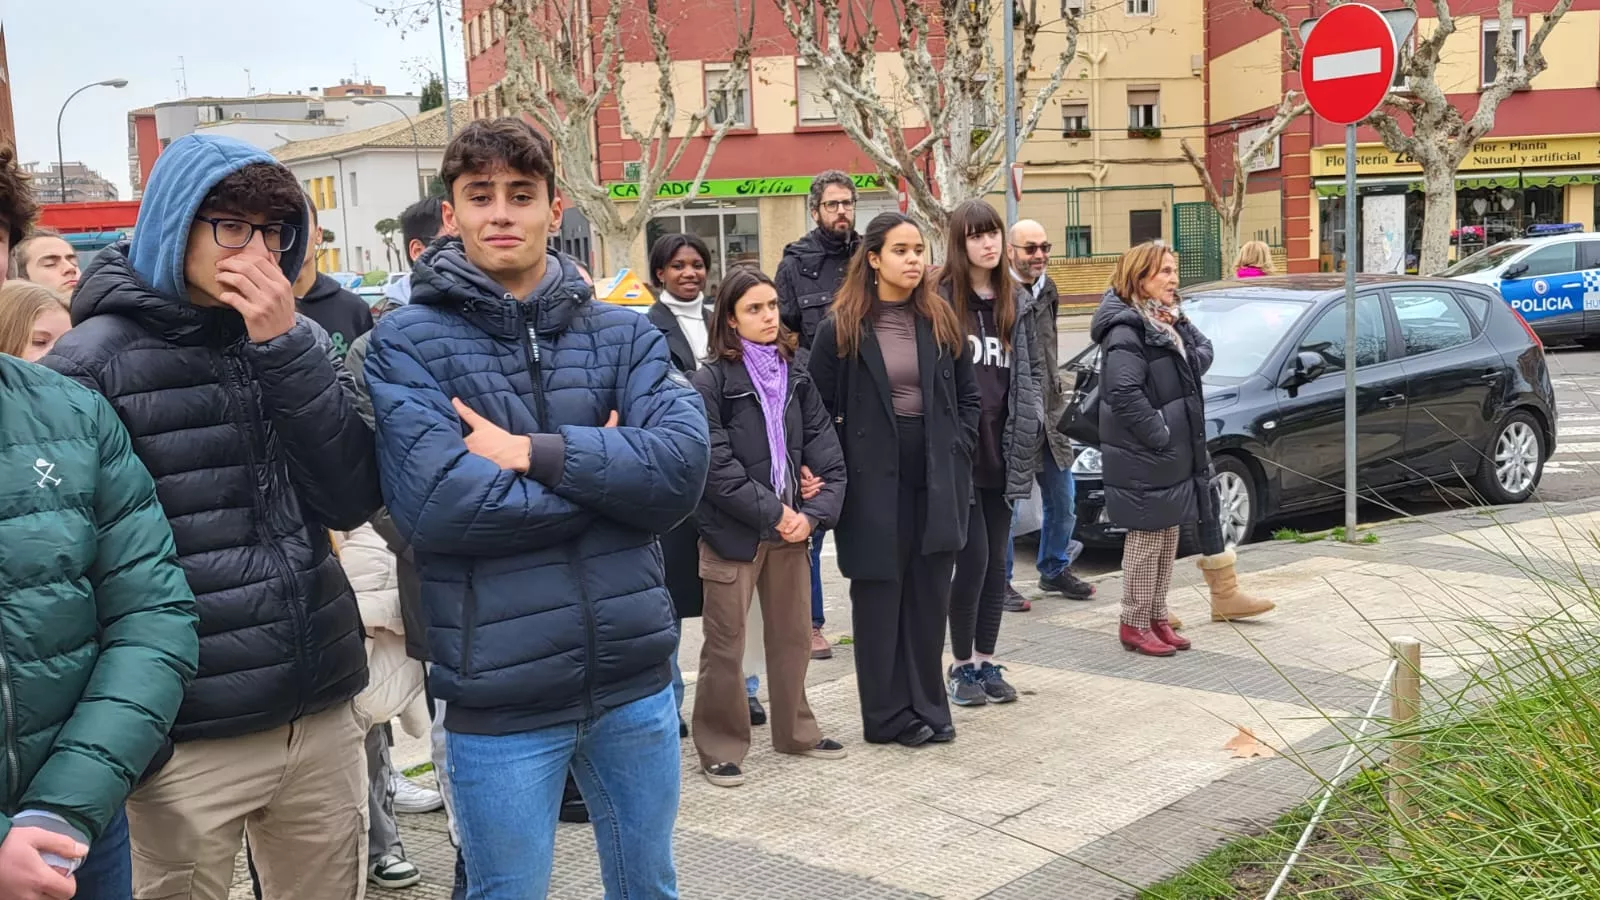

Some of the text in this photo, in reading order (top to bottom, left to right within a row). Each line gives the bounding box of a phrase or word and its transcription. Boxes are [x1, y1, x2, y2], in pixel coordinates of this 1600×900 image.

[1473, 143, 1497, 153] Flor
[1510, 142, 1547, 151] Planta
[1326, 153, 1388, 167] Flostería
[1473, 151, 1581, 165] Natural y artificial
[613, 181, 711, 197] CAADOS
[1511, 297, 1573, 312] POLICIA
